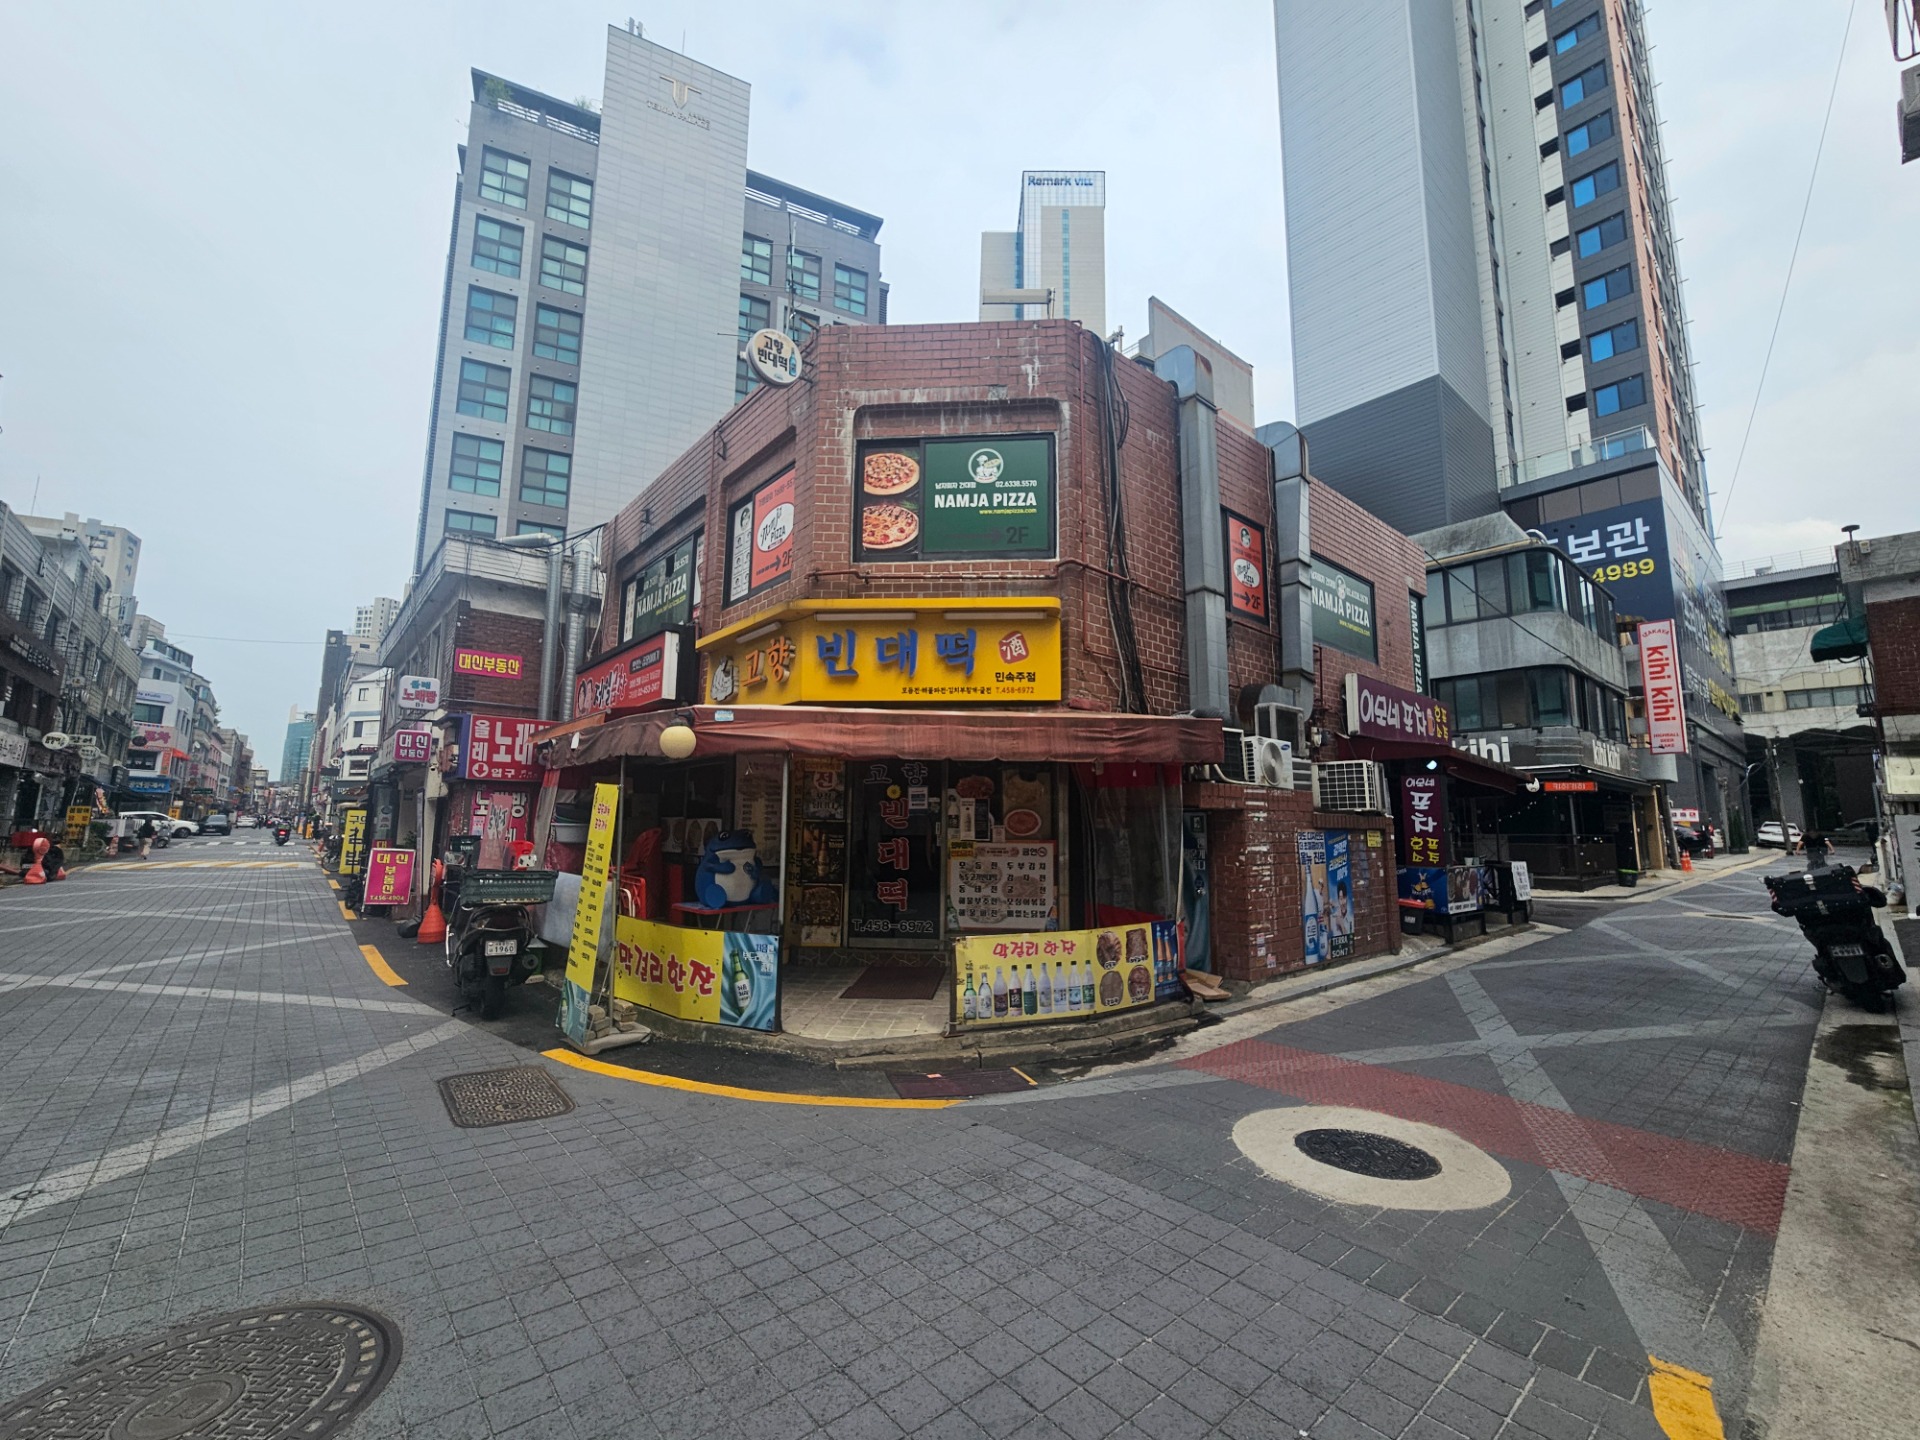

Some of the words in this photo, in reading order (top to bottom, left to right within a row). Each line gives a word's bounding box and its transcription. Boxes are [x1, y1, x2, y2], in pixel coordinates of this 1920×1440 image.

[1028, 176, 1071, 186] Remark
[764, 335, 784, 355] 고향
[757, 347, 788, 371] 빈대떡
[995, 480, 1037, 488] 02.6338.5570
[934, 493, 989, 508] NAMJA
[993, 492, 1037, 507] PIZZA
[770, 525, 786, 542] PIZZA
[1006, 526, 1029, 544] 2F
[782, 548, 793, 567] 2F
[1592, 558, 1655, 583] 4989
[636, 588, 662, 618] NAMJA
[664, 573, 687, 602] PIZZA
[1251, 594, 1261, 610] 2F
[1311, 586, 1344, 616] NAMJA
[1346, 601, 1370, 628] PIZZA
[1410, 600, 1420, 650] NAMJA
[1642, 629, 1670, 639] IZAKAYA
[816, 628, 977, 678] 빈대떡
[1001, 634, 1026, 660] 酒
[458, 653, 520, 675] 대신부동산
[741, 636, 795, 687] 고향
[1646, 645, 1671, 681] kihi
[995, 671, 1036, 683] 민속주점
[1413, 653, 1423, 693] PIZZA
[402, 688, 437, 704] 노래방
[1651, 686, 1676, 722] kihi
[1360, 689, 1400, 729] 이모네
[1402, 700, 1427, 737] 포차
[399, 734, 428, 748] 대신
[400, 749, 424, 758] 부동산
[1593, 739, 1607, 766] kihi
[1607, 744, 1620, 770] kihi
[491, 768, 516, 778] 입구
[816, 771, 835, 789] 전
[864, 762, 928, 786] 고향
[1405, 778, 1435, 787] 이모네
[1410, 791, 1437, 832] 포차
[376, 853, 409, 864] 대신
[877, 798, 910, 911] 빈대떡
[1313, 852, 1326, 864] 진로
[1007, 862, 1046, 871] 두부김치
[382, 866, 396, 894] 부동산
[852, 919, 933, 933] T.458-6972
[495, 945, 514, 953] 1960
[1332, 935, 1348, 946] TERRA
[993, 942, 1039, 959] 막걸리
[618, 942, 664, 984] 막걸리
